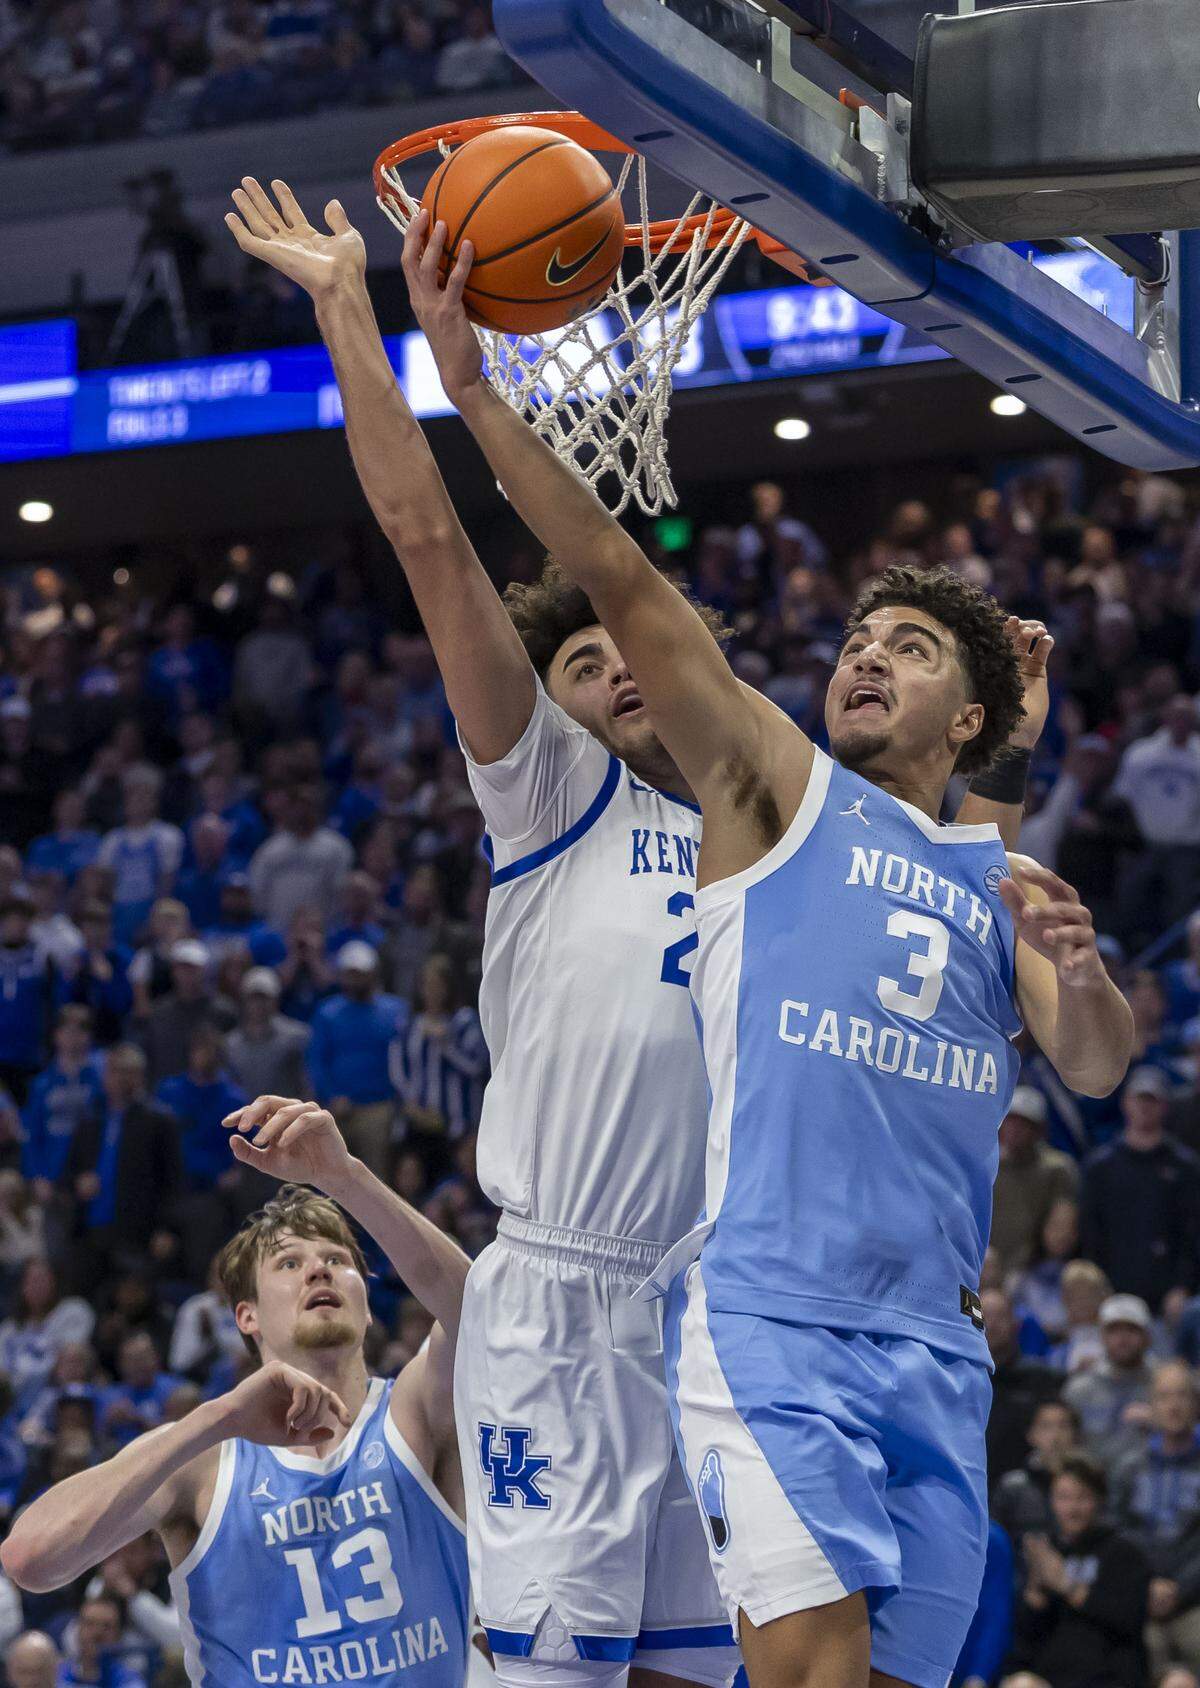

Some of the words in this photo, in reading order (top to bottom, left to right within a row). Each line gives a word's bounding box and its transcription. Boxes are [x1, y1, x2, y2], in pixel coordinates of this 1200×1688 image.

[630, 829, 700, 878] KEN
[845, 846, 992, 946] NORTH
[877, 909, 950, 1022] 3
[778, 999, 999, 1095] CAROLINA
[478, 1421, 551, 1510] UK
[261, 1481, 391, 1546] NORTH
[283, 1527, 403, 1639] 13
[251, 1616, 449, 1685] CAROLINA
